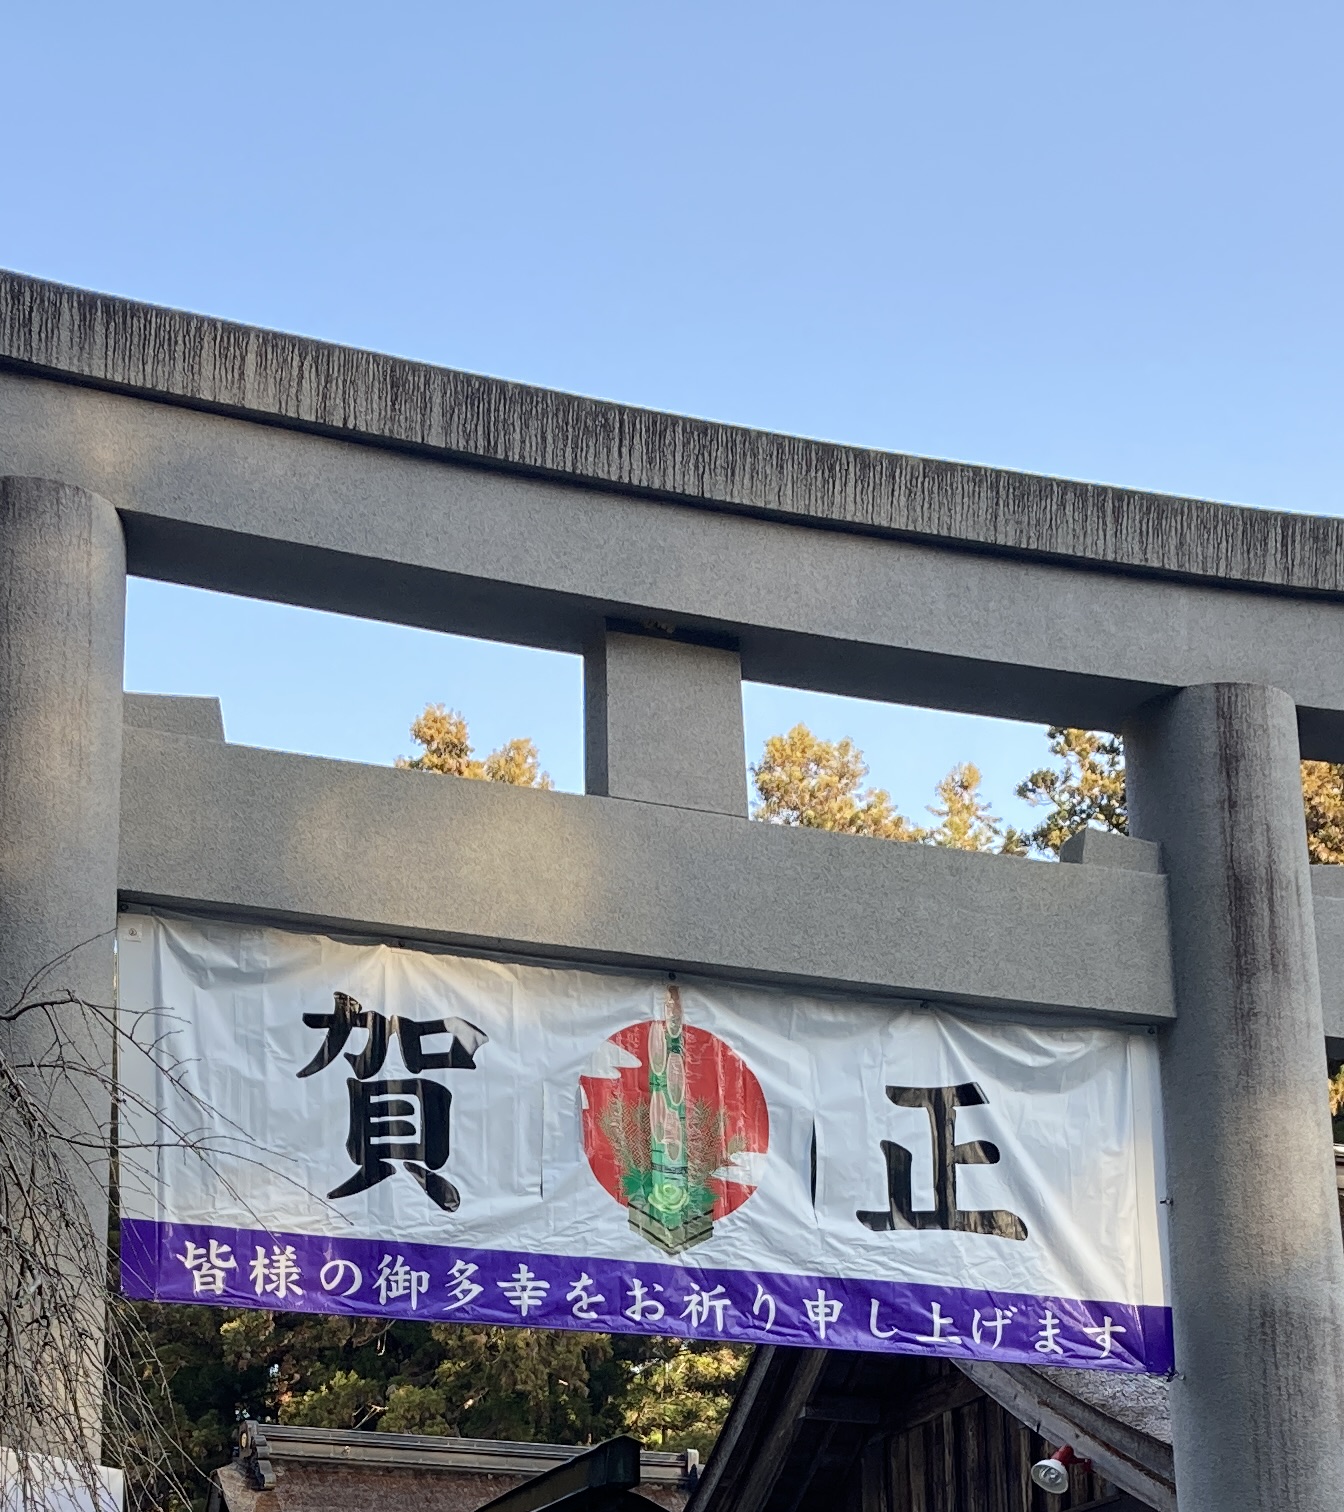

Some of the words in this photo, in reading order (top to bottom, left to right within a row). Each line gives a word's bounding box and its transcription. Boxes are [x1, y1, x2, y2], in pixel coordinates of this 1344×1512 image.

[296, 991, 489, 1213] 賀
[856, 1081, 1029, 1242] 正
[179, 1240, 1129, 1359] 皆様の御多幸をお祈り申し上げます
